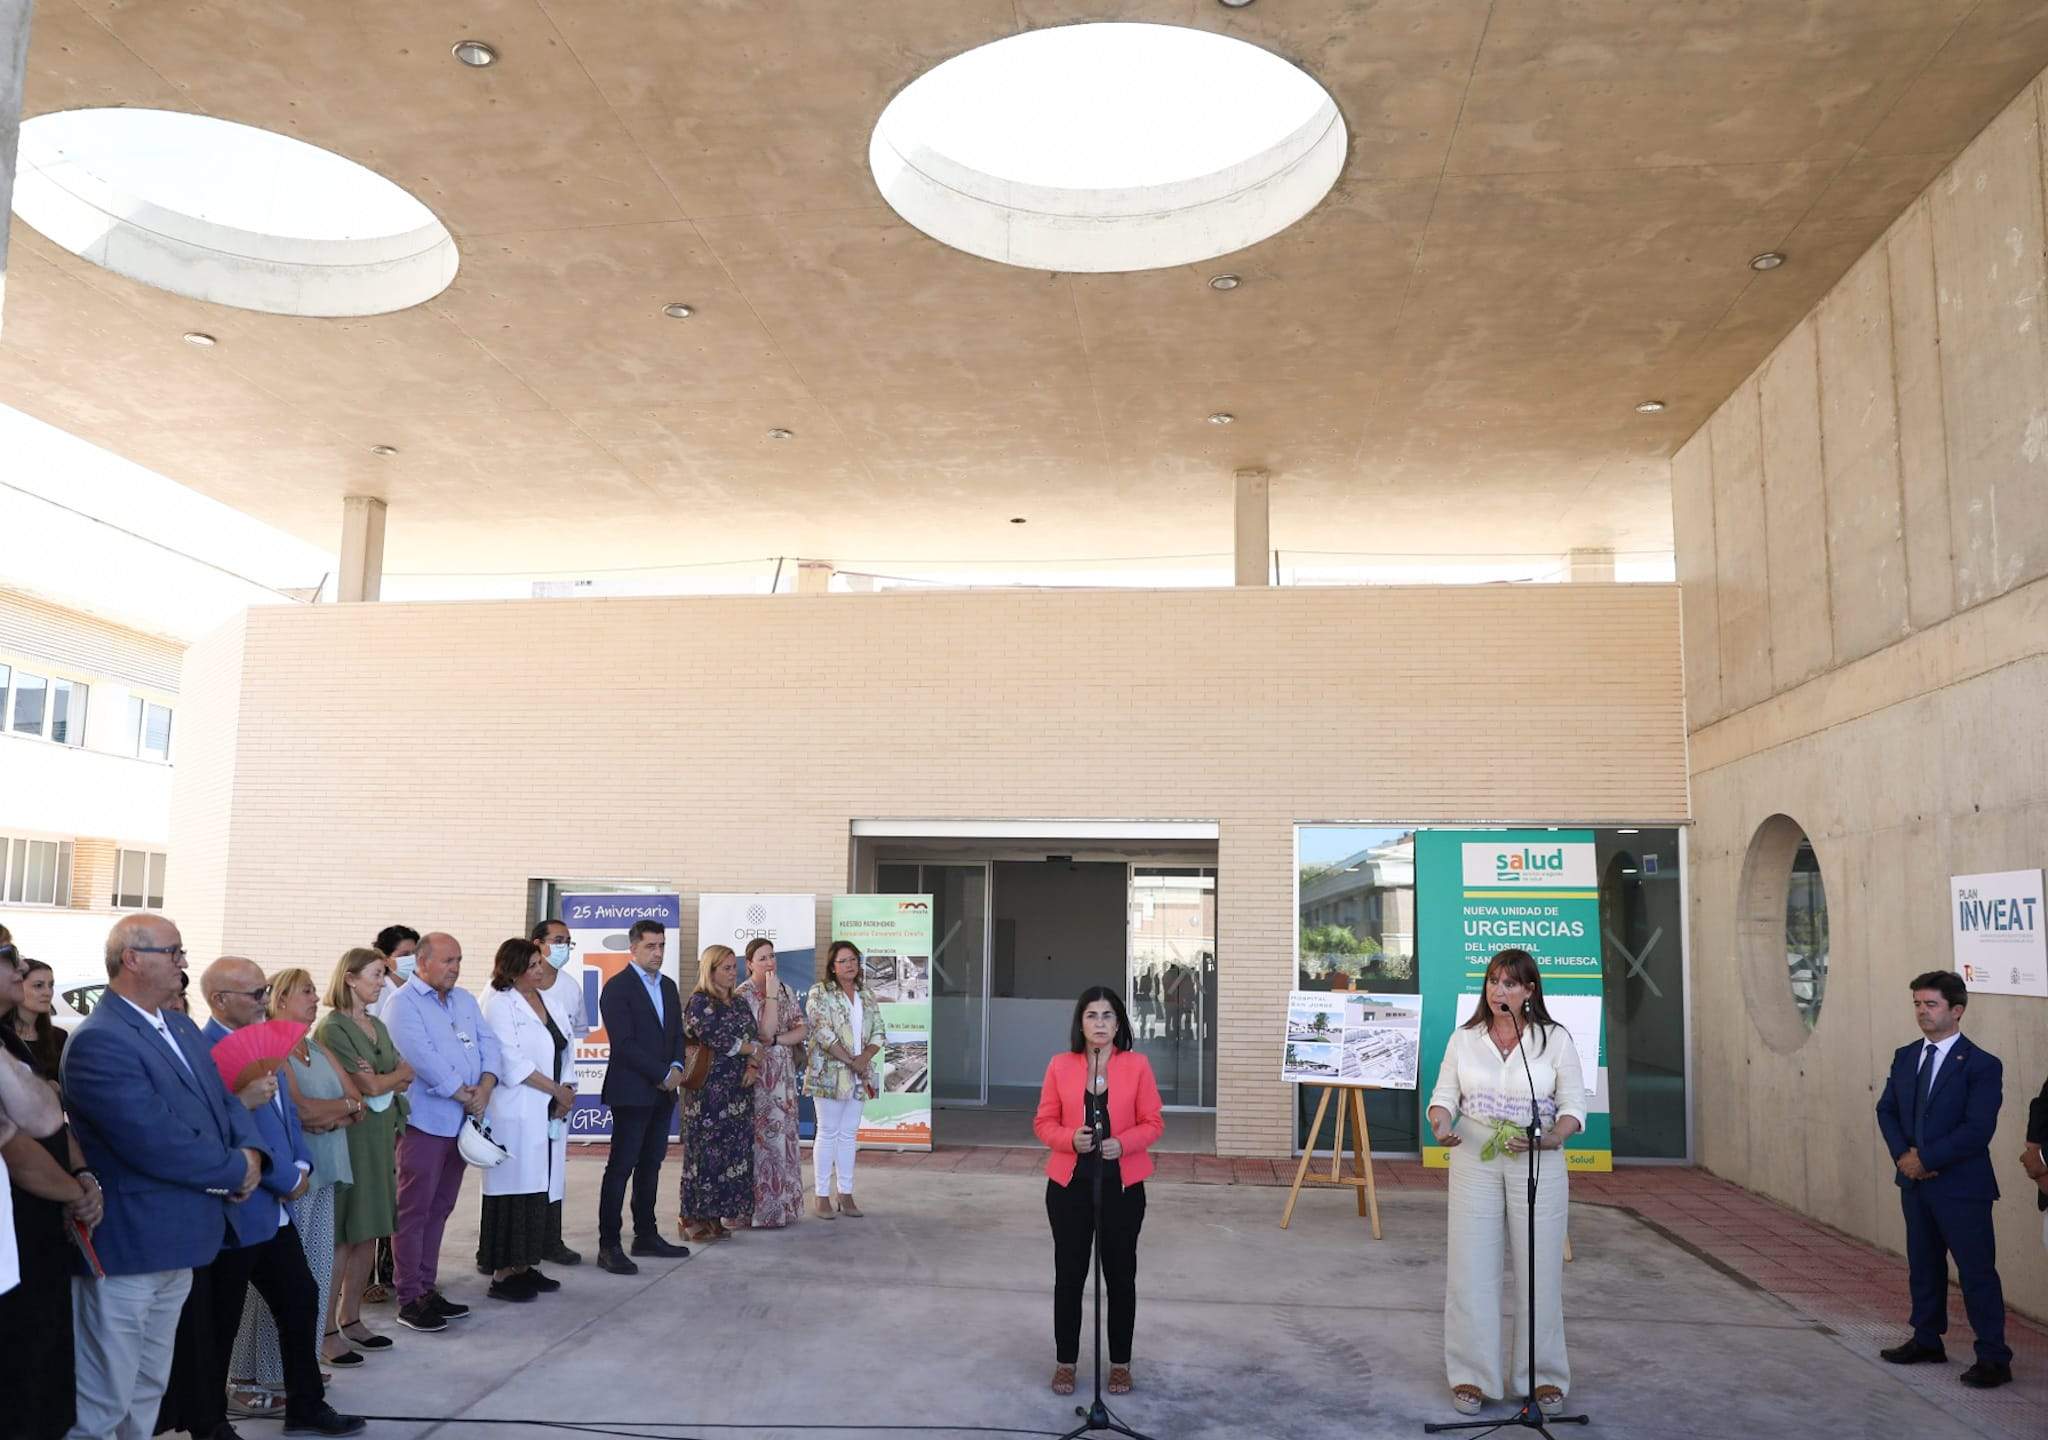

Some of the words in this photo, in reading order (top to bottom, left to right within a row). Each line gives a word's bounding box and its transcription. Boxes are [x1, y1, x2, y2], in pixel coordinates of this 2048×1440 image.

[1496, 848, 1563, 871] salud
[1959, 888, 1978, 900] PLAN
[572, 905, 592, 919] 25
[595, 904, 669, 919] Aniversario
[1463, 906, 1499, 916] NUEVA
[1501, 906, 1542, 916] UNIDAD
[1544, 906, 1559, 916] DE
[1959, 898, 2036, 931] INVEAT
[734, 928, 777, 940] ORBE
[1463, 920, 1585, 937] URGENCIAS
[1464, 942, 1485, 952] DEL
[1488, 942, 1540, 953] HOSPITAL
[1537, 956, 1552, 966] DE
[1554, 956, 1598, 966] HUESCA
